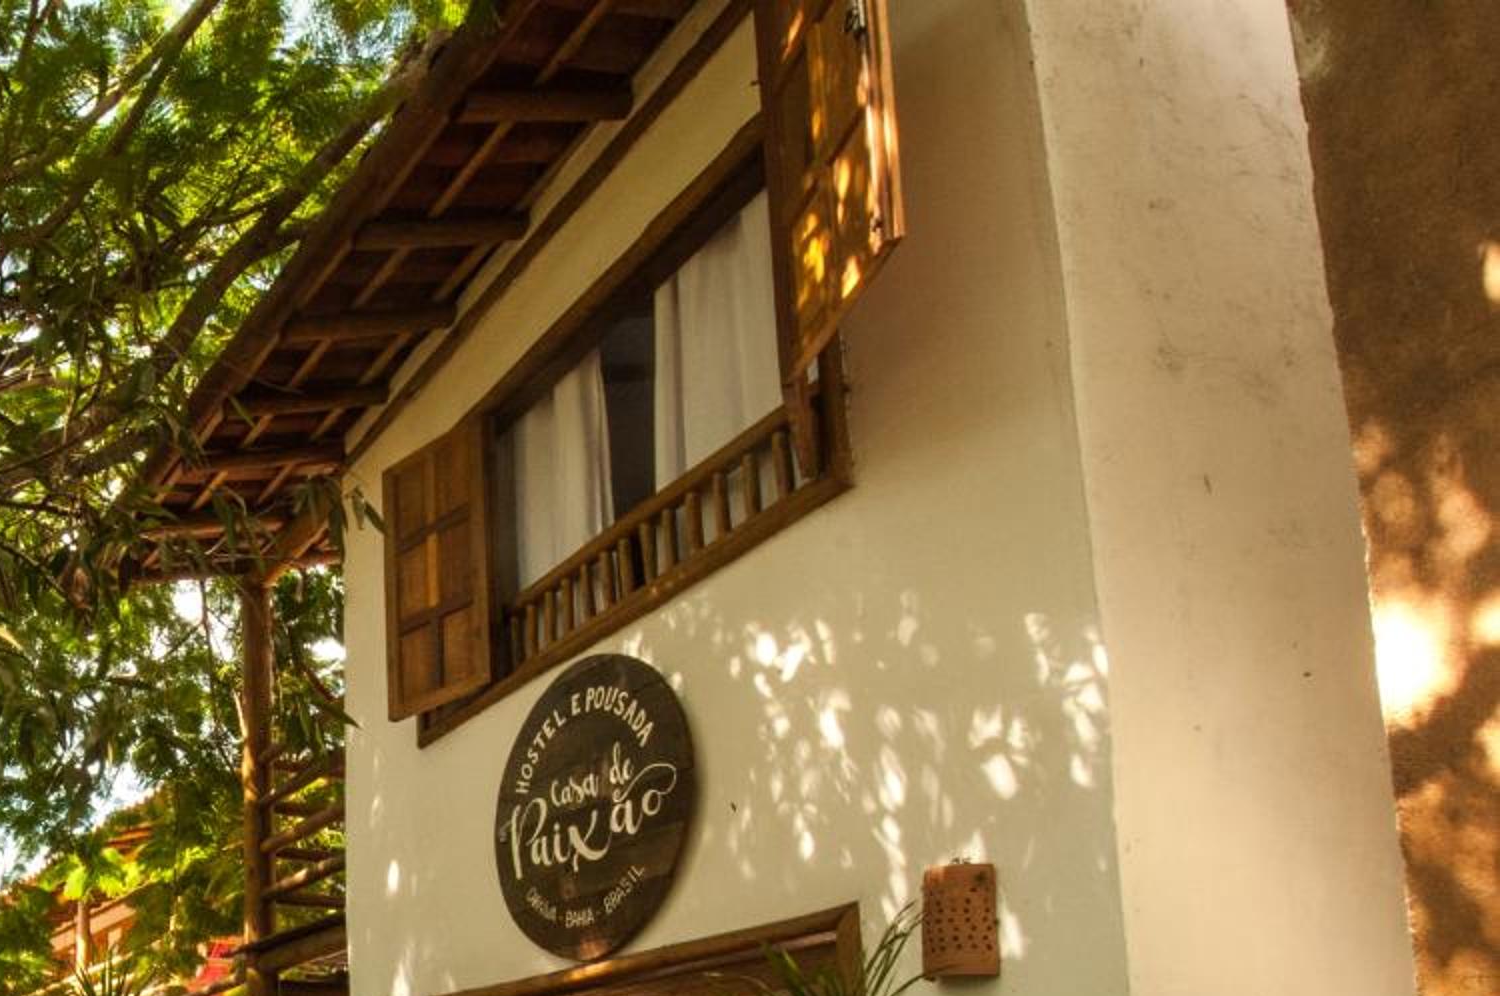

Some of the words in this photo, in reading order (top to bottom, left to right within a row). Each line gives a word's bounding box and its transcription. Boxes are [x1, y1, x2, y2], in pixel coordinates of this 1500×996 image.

[516, 709, 567, 794] HOSTEL
[571, 693, 582, 716] E
[585, 686, 655, 747] POUSADA
[501, 763, 677, 880] Paixão
[551, 773, 600, 807] Casa
[603, 865, 645, 914] BRASIL
